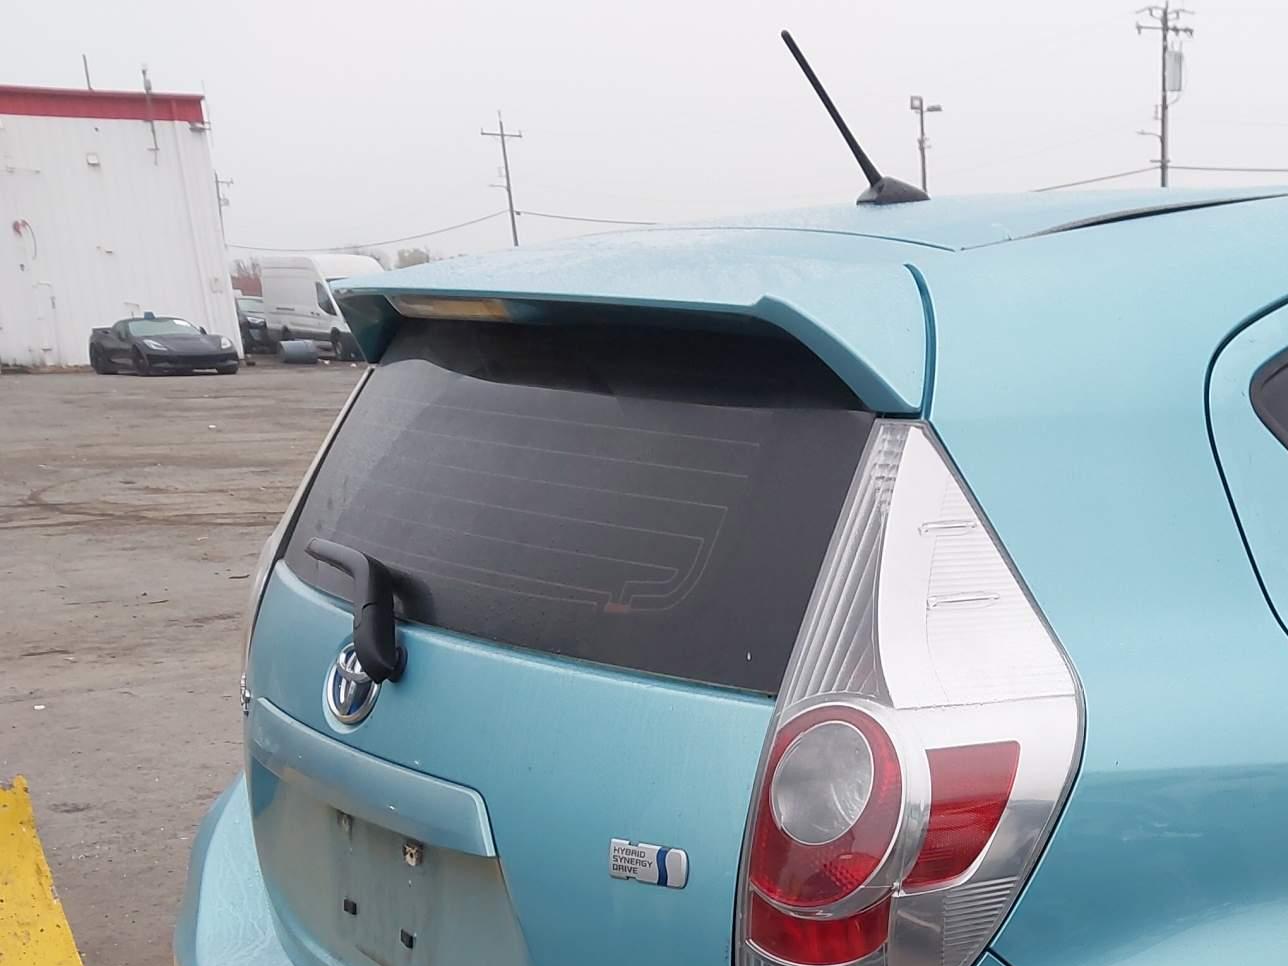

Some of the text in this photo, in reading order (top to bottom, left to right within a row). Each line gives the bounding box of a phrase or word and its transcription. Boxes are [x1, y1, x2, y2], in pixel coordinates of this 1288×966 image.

[613, 846, 646, 858] HYBRID
[612, 855, 653, 869] SYNERGY
[612, 863, 639, 875] DRIVE
